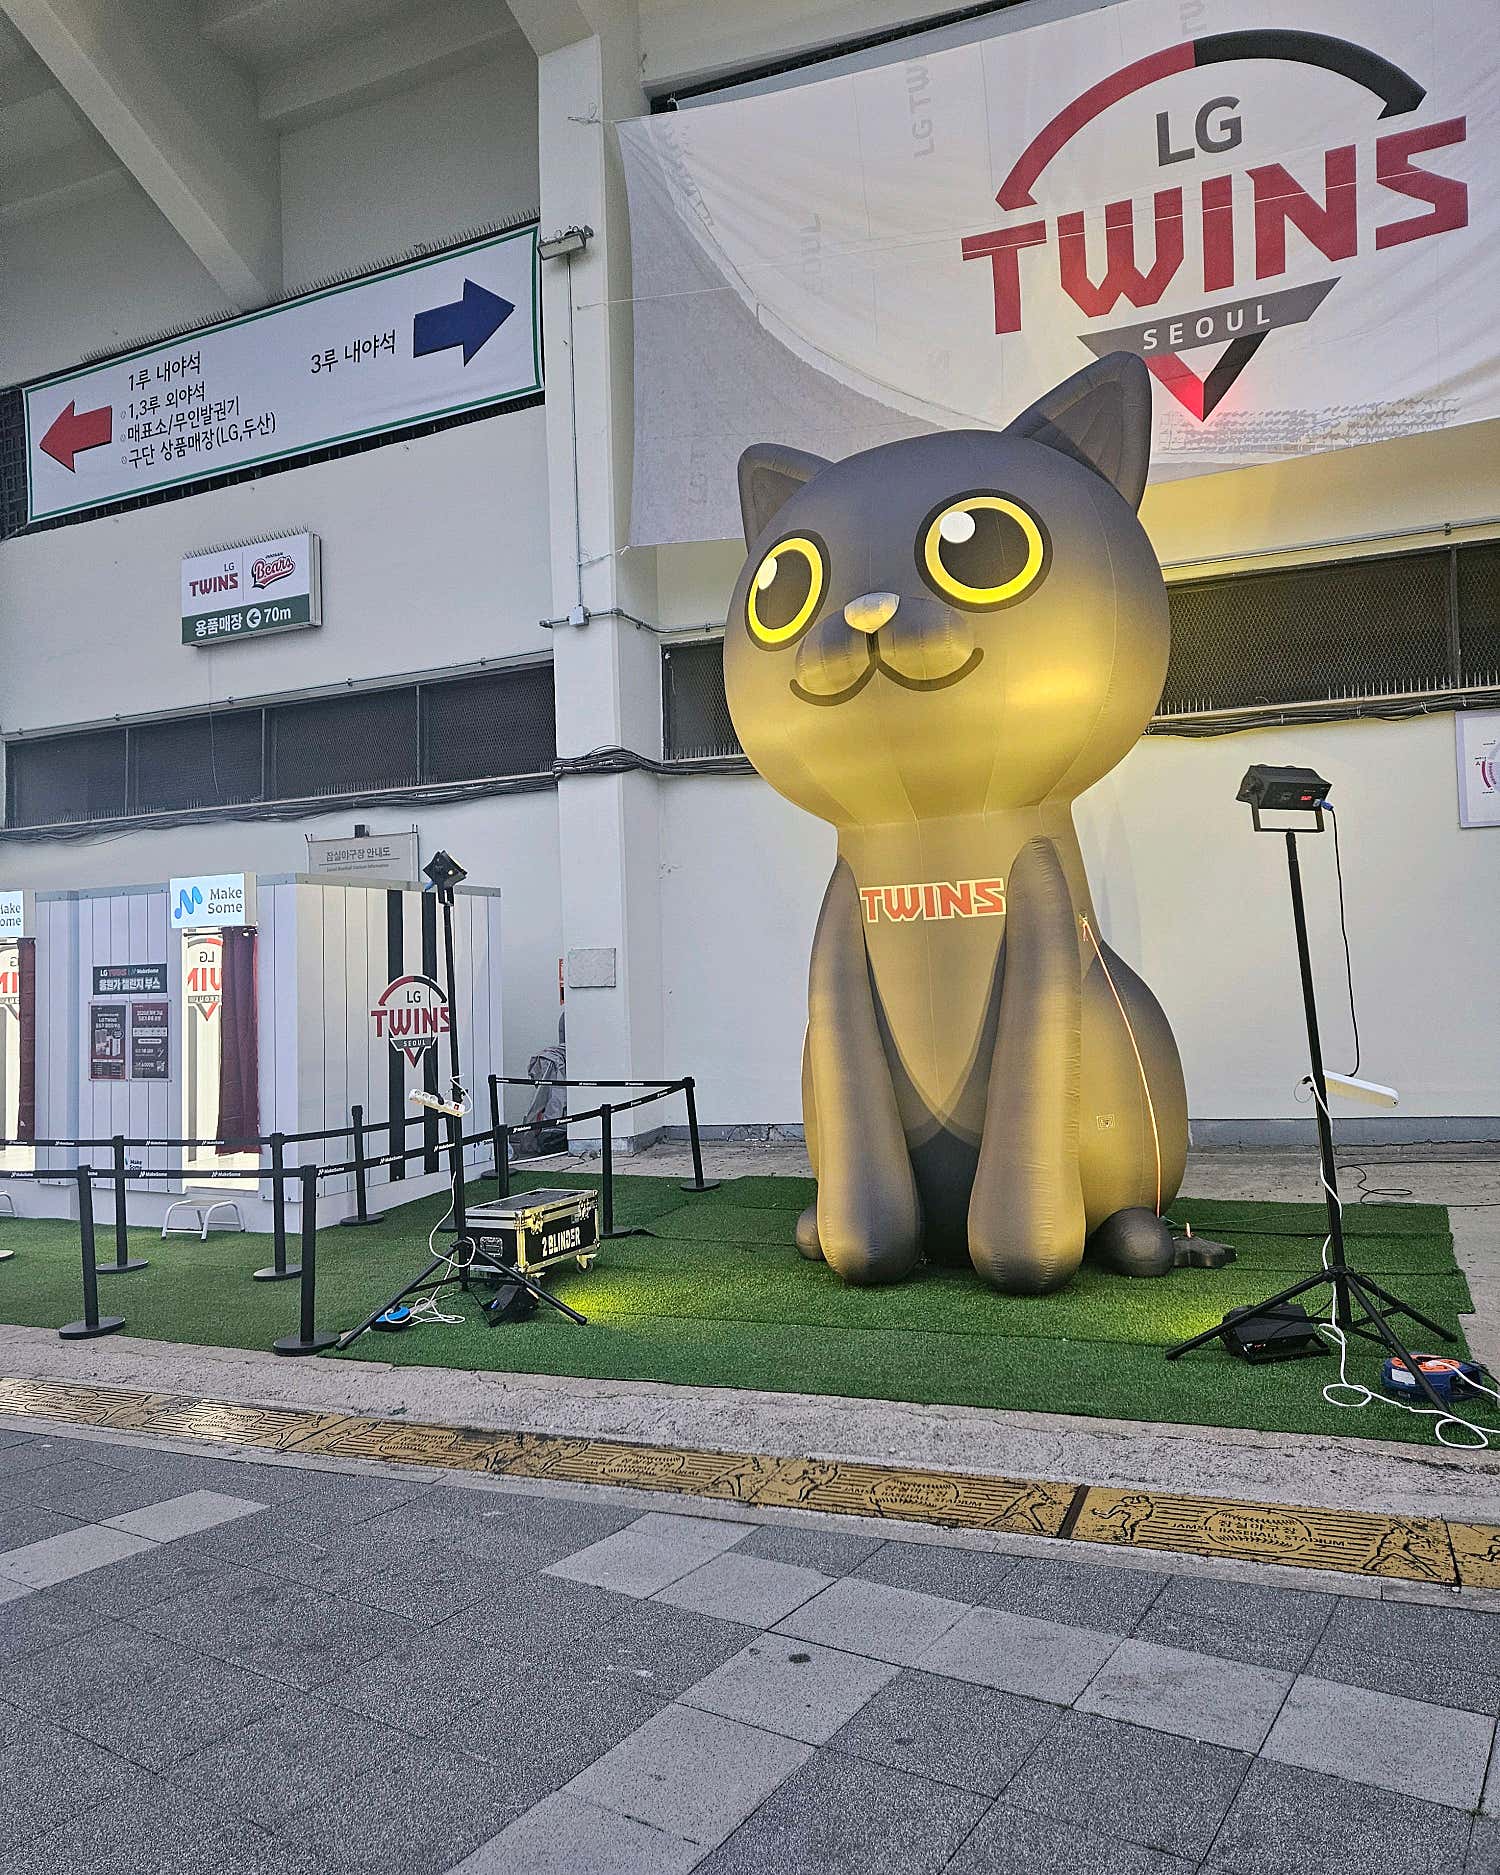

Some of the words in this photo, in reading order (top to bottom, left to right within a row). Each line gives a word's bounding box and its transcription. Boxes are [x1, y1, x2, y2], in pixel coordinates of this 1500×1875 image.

[1156, 96, 1243, 167] LG
[961, 116, 1469, 335] TWINS
[1143, 304, 1271, 350] SEOUL
[310, 349, 339, 374] 3루
[344, 329, 396, 363] 내야석
[129, 369, 151, 392] 1루
[156, 351, 201, 383] 내야석
[129, 396, 161, 420] 1,3루
[165, 381, 205, 409] 외야석
[128, 396, 240, 443] 매표소/무인발권기
[129, 444, 156, 469] 구단
[160, 411, 277, 462] 상품매장(LG,두산)
[224, 562, 235, 572] LG
[252, 556, 295, 583] Bears
[189, 572, 239, 597] TWINS
[194, 613, 243, 638] 용품매장
[263, 606, 292, 623] 70m
[366, 846, 392, 859] 안내도
[207, 903, 243, 915] Some
[210, 887, 243, 901] Make
[859, 878, 1007, 923] TWINS
[0, 917, 22, 927] ome
[406, 990, 422, 1004] LG
[371, 1007, 451, 1037] TWINS
[542, 1236, 548, 1257] 2
[548, 1227, 581, 1254] BLINDER
